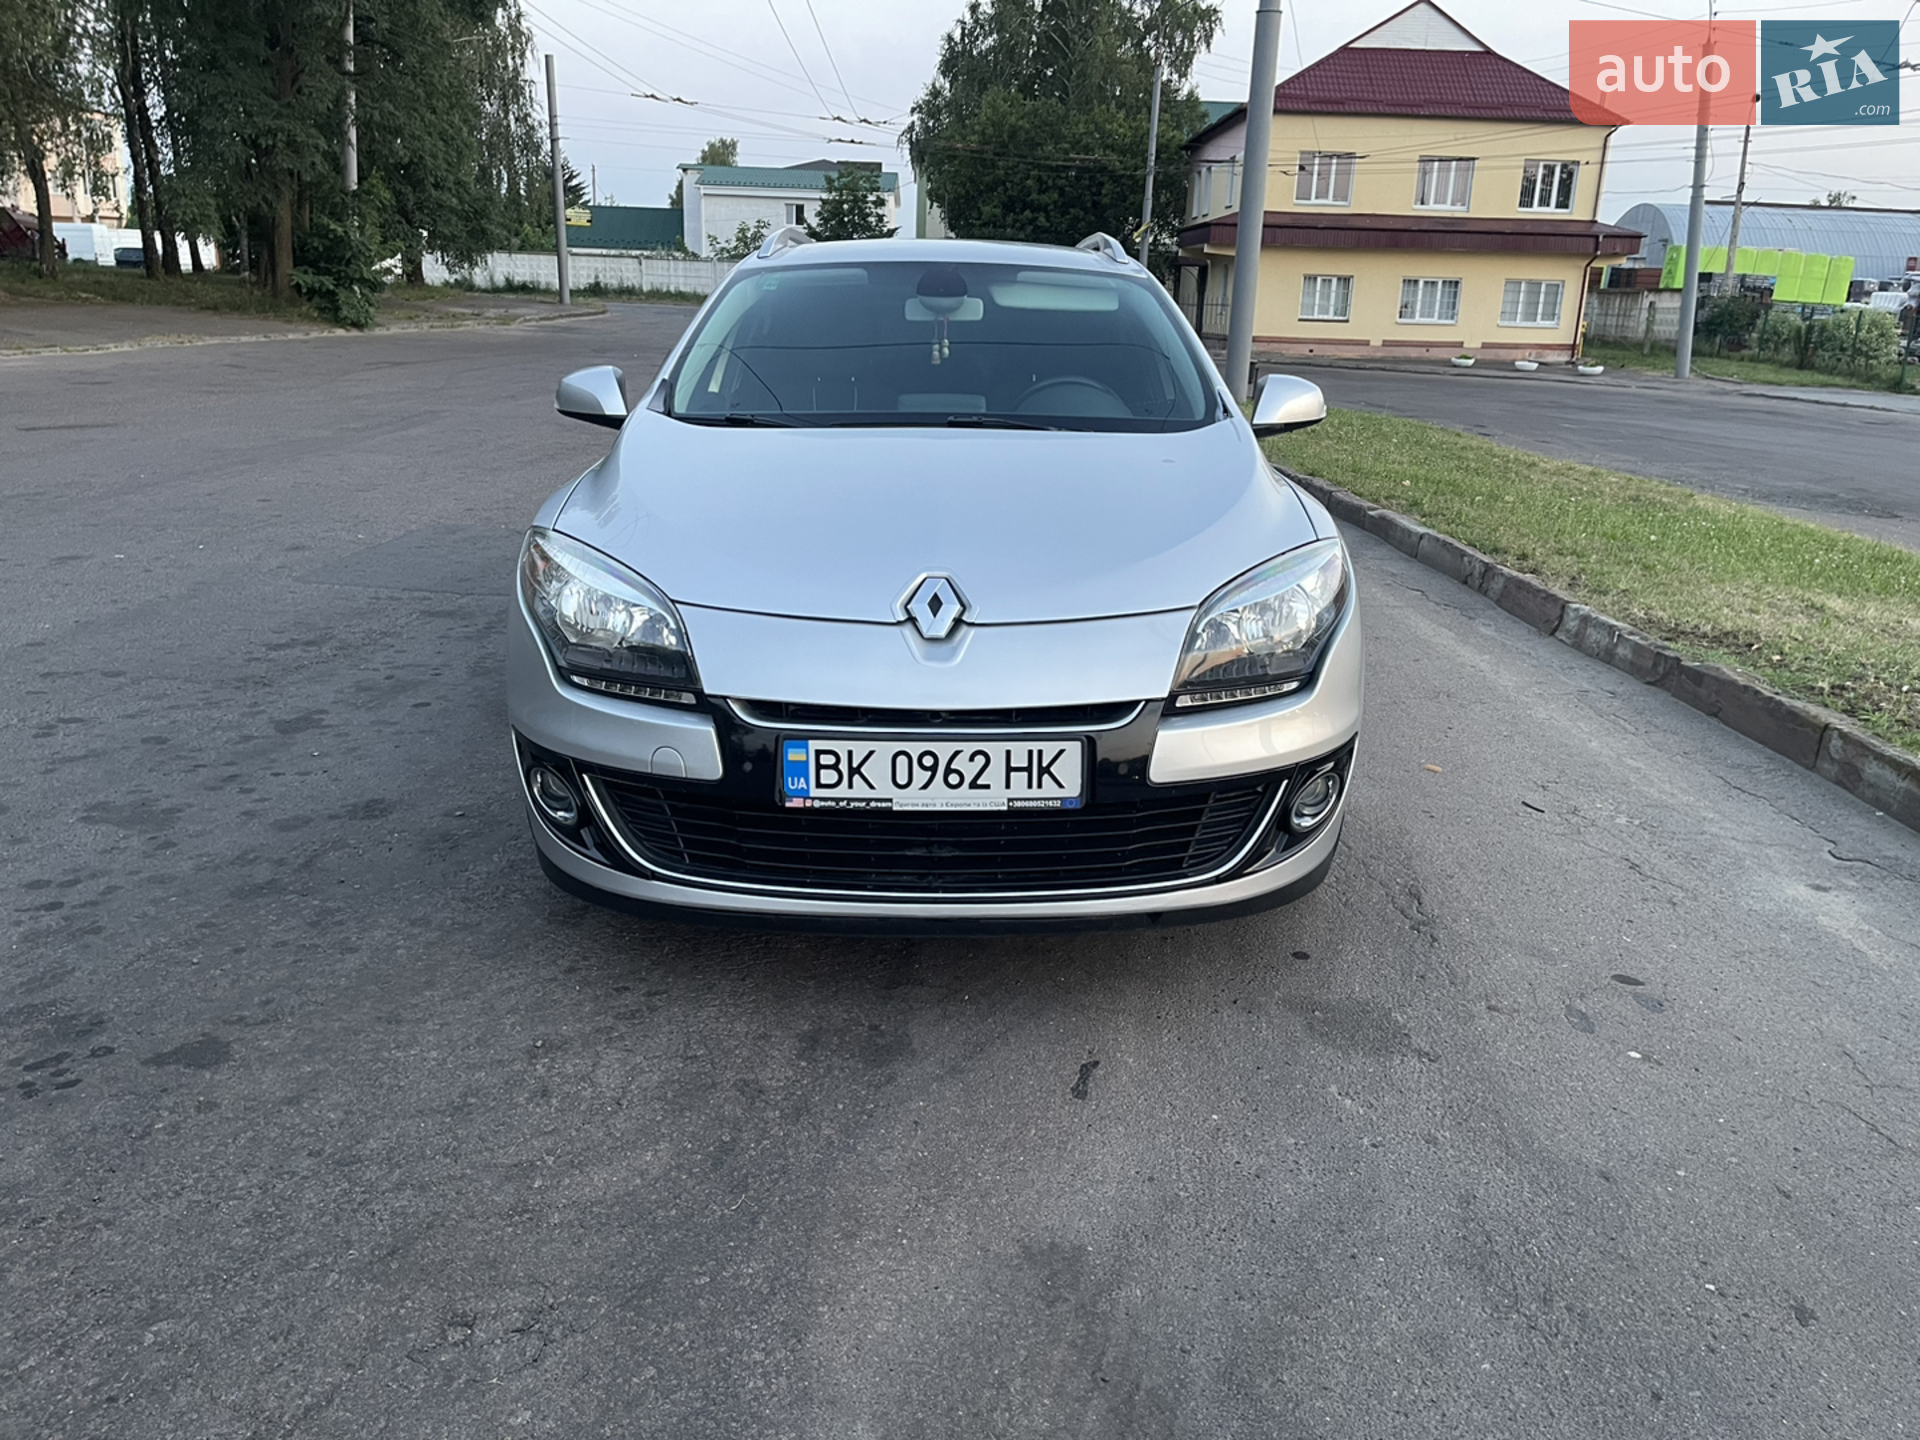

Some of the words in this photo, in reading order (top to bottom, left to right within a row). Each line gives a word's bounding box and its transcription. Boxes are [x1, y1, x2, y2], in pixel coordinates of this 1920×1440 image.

[788, 776, 808, 790] UA
[814, 748, 877, 790] BK
[890, 749, 992, 790] 0962
[1004, 748, 1067, 790] HK
